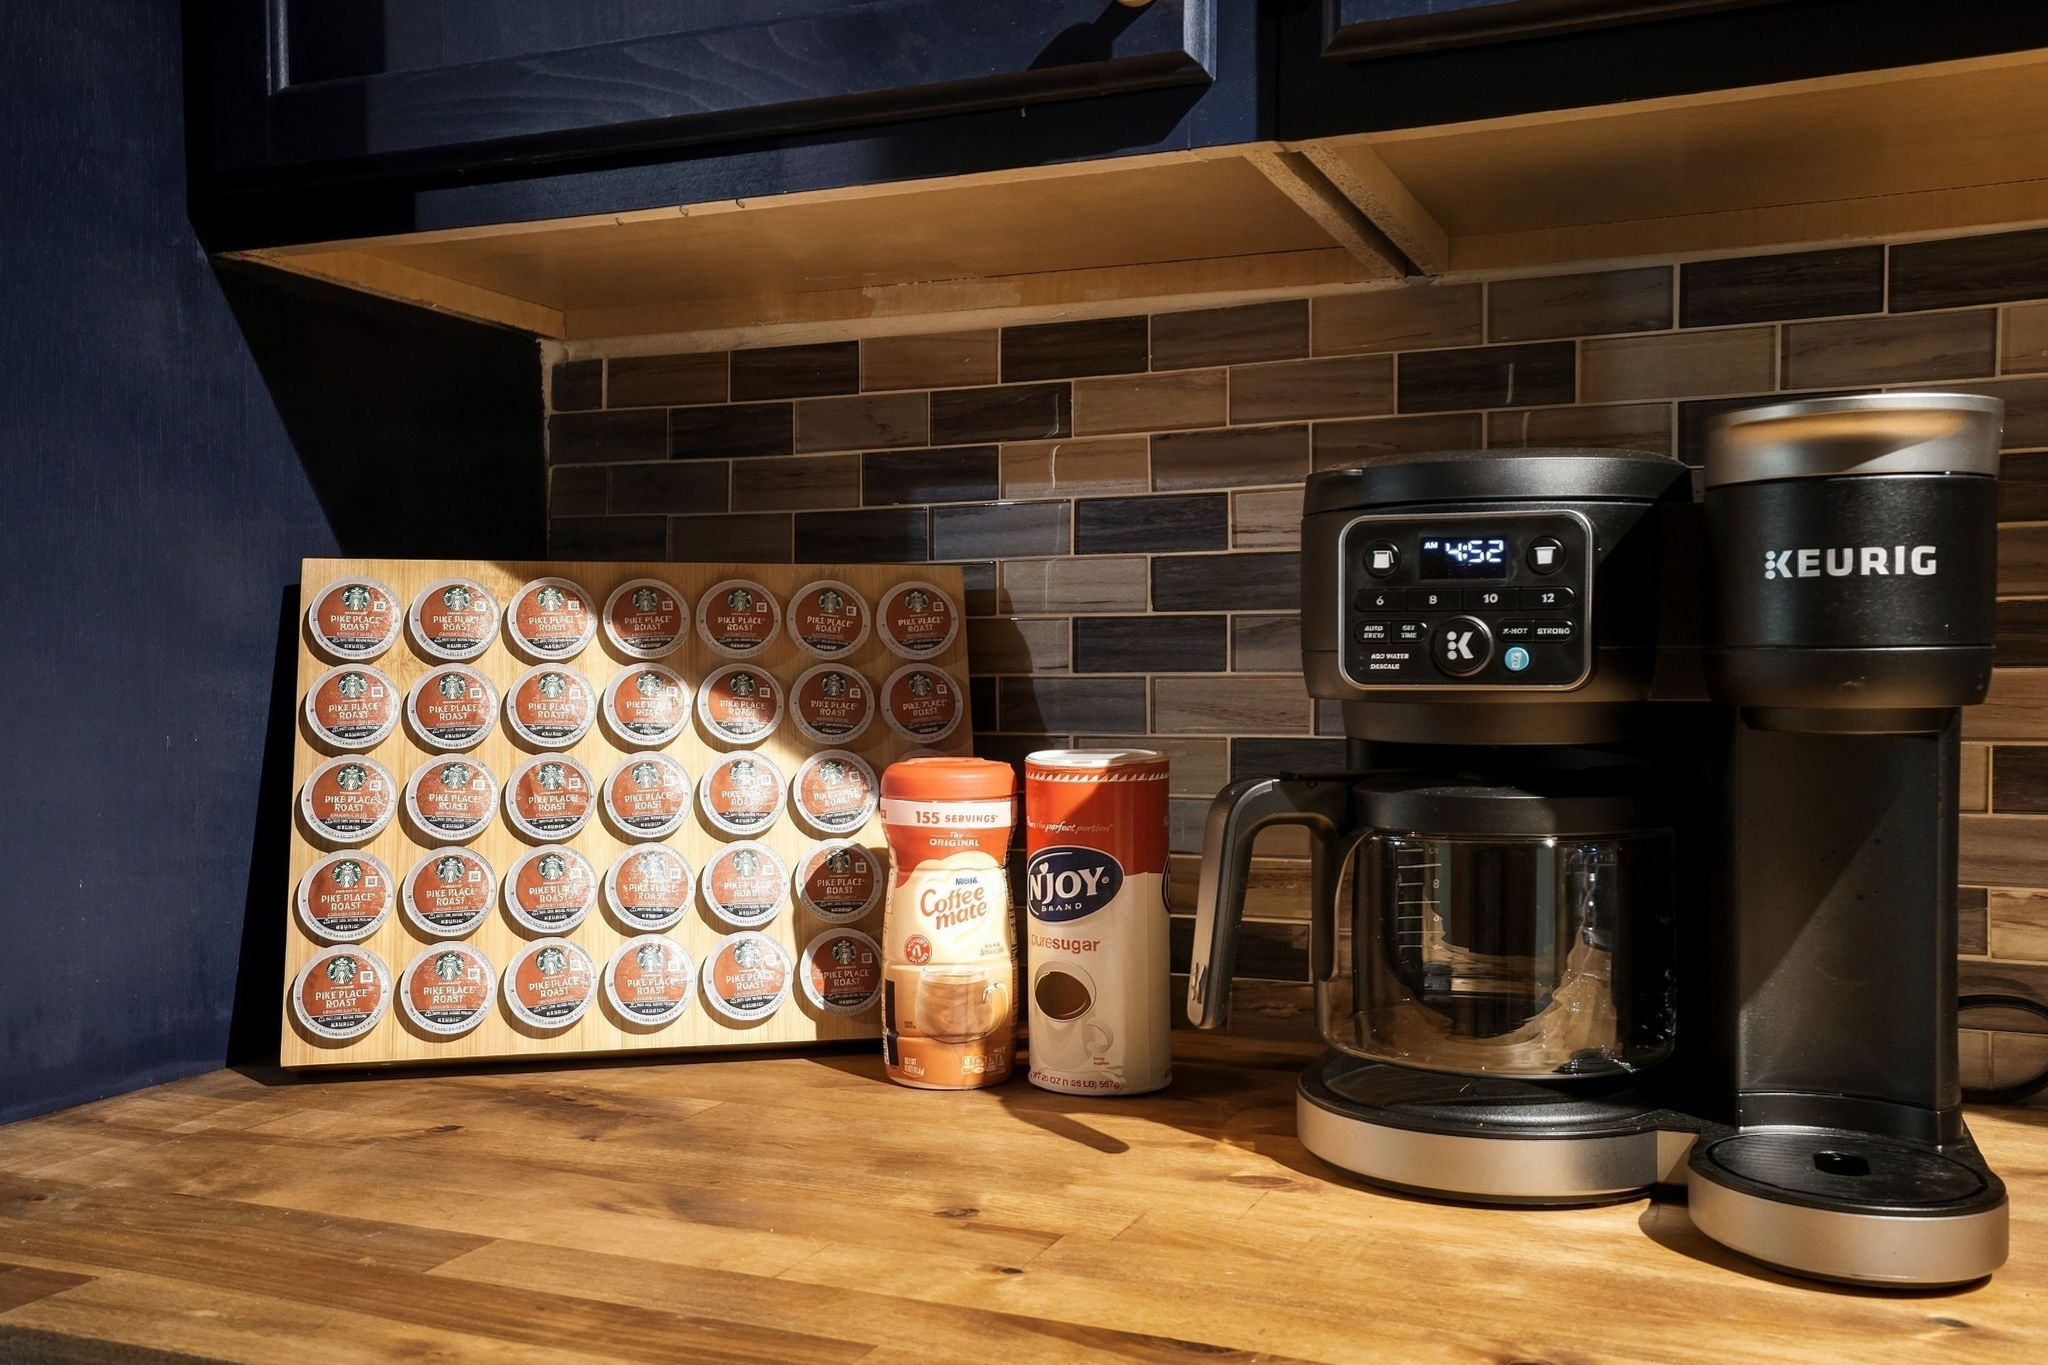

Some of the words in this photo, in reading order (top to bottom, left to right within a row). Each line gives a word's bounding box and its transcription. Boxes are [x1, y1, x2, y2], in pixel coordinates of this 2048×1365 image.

[1445, 540, 1504, 563] 4:52
[1765, 546, 1937, 579] KEURIG
[1376, 595, 1384, 606] 6
[1429, 594, 1437, 604] 8
[1483, 593, 1498, 604] 10
[1541, 592, 1555, 603] 12
[353, 615, 380, 625] PLACE
[434, 615, 452, 623] PIKE
[550, 616, 575, 624] PLACE
[807, 616, 825, 624] PIKE
[827, 619, 851, 628] PLACE
[815, 625, 842, 633] ROAST
[1502, 627, 1528, 635] X-HOT
[1536, 627, 1571, 635] STRONG
[352, 702, 379, 711] PLACE
[451, 704, 476, 712] PLACE
[741, 701, 766, 709] PLACE
[831, 702, 856, 710] PLACE
[339, 711, 369, 719] ROAST
[913, 708, 937, 716] ROAST
[439, 713, 468, 721] ROAST
[624, 794, 643, 802] PIKE
[646, 792, 672, 800] PLACE
[722, 790, 740, 798] PIKE
[452, 795, 479, 803] PLACE
[529, 795, 547, 803] PIKE
[438, 802, 468, 810] ROAST
[539, 803, 566, 811] ROAST
[634, 801, 662, 810] ROAST
[915, 811, 940, 824] 155
[1045, 821, 1076, 833] perfect
[724, 882, 743, 890] PIKE
[817, 879, 836, 887] PIKE
[1433, 879, 1440, 889] 8
[427, 889, 446, 897] PIKE
[449, 889, 475, 897] PLACE
[638, 892, 666, 900] ROAST
[322, 894, 341, 903] PIKE
[344, 894, 372, 902] PLACE
[540, 894, 567, 902] ROAST
[921, 887, 984, 917] Coffee
[1041, 903, 1082, 912] BRAND
[936, 902, 987, 930] mate
[726, 975, 746, 983] PIKE
[824, 970, 842, 979] PIKE
[529, 982, 549, 991] PIKE
[552, 978, 579, 987] PLACE
[627, 979, 647, 987] PIKE
[737, 982, 764, 991] ROAST
[834, 978, 860, 987] ROAST
[316, 991, 336, 1000] PIKE
[338, 988, 367, 998] PLACE
[424, 986, 444, 995] PIKE
[446, 986, 474, 994] PLACE
[541, 987, 568, 998] ROAST
[637, 987, 665, 995] ROAST
[326, 998, 356, 1008] ROAST
[433, 995, 463, 1003] ROAST
[1084, 1080, 1096, 1089] LB)
